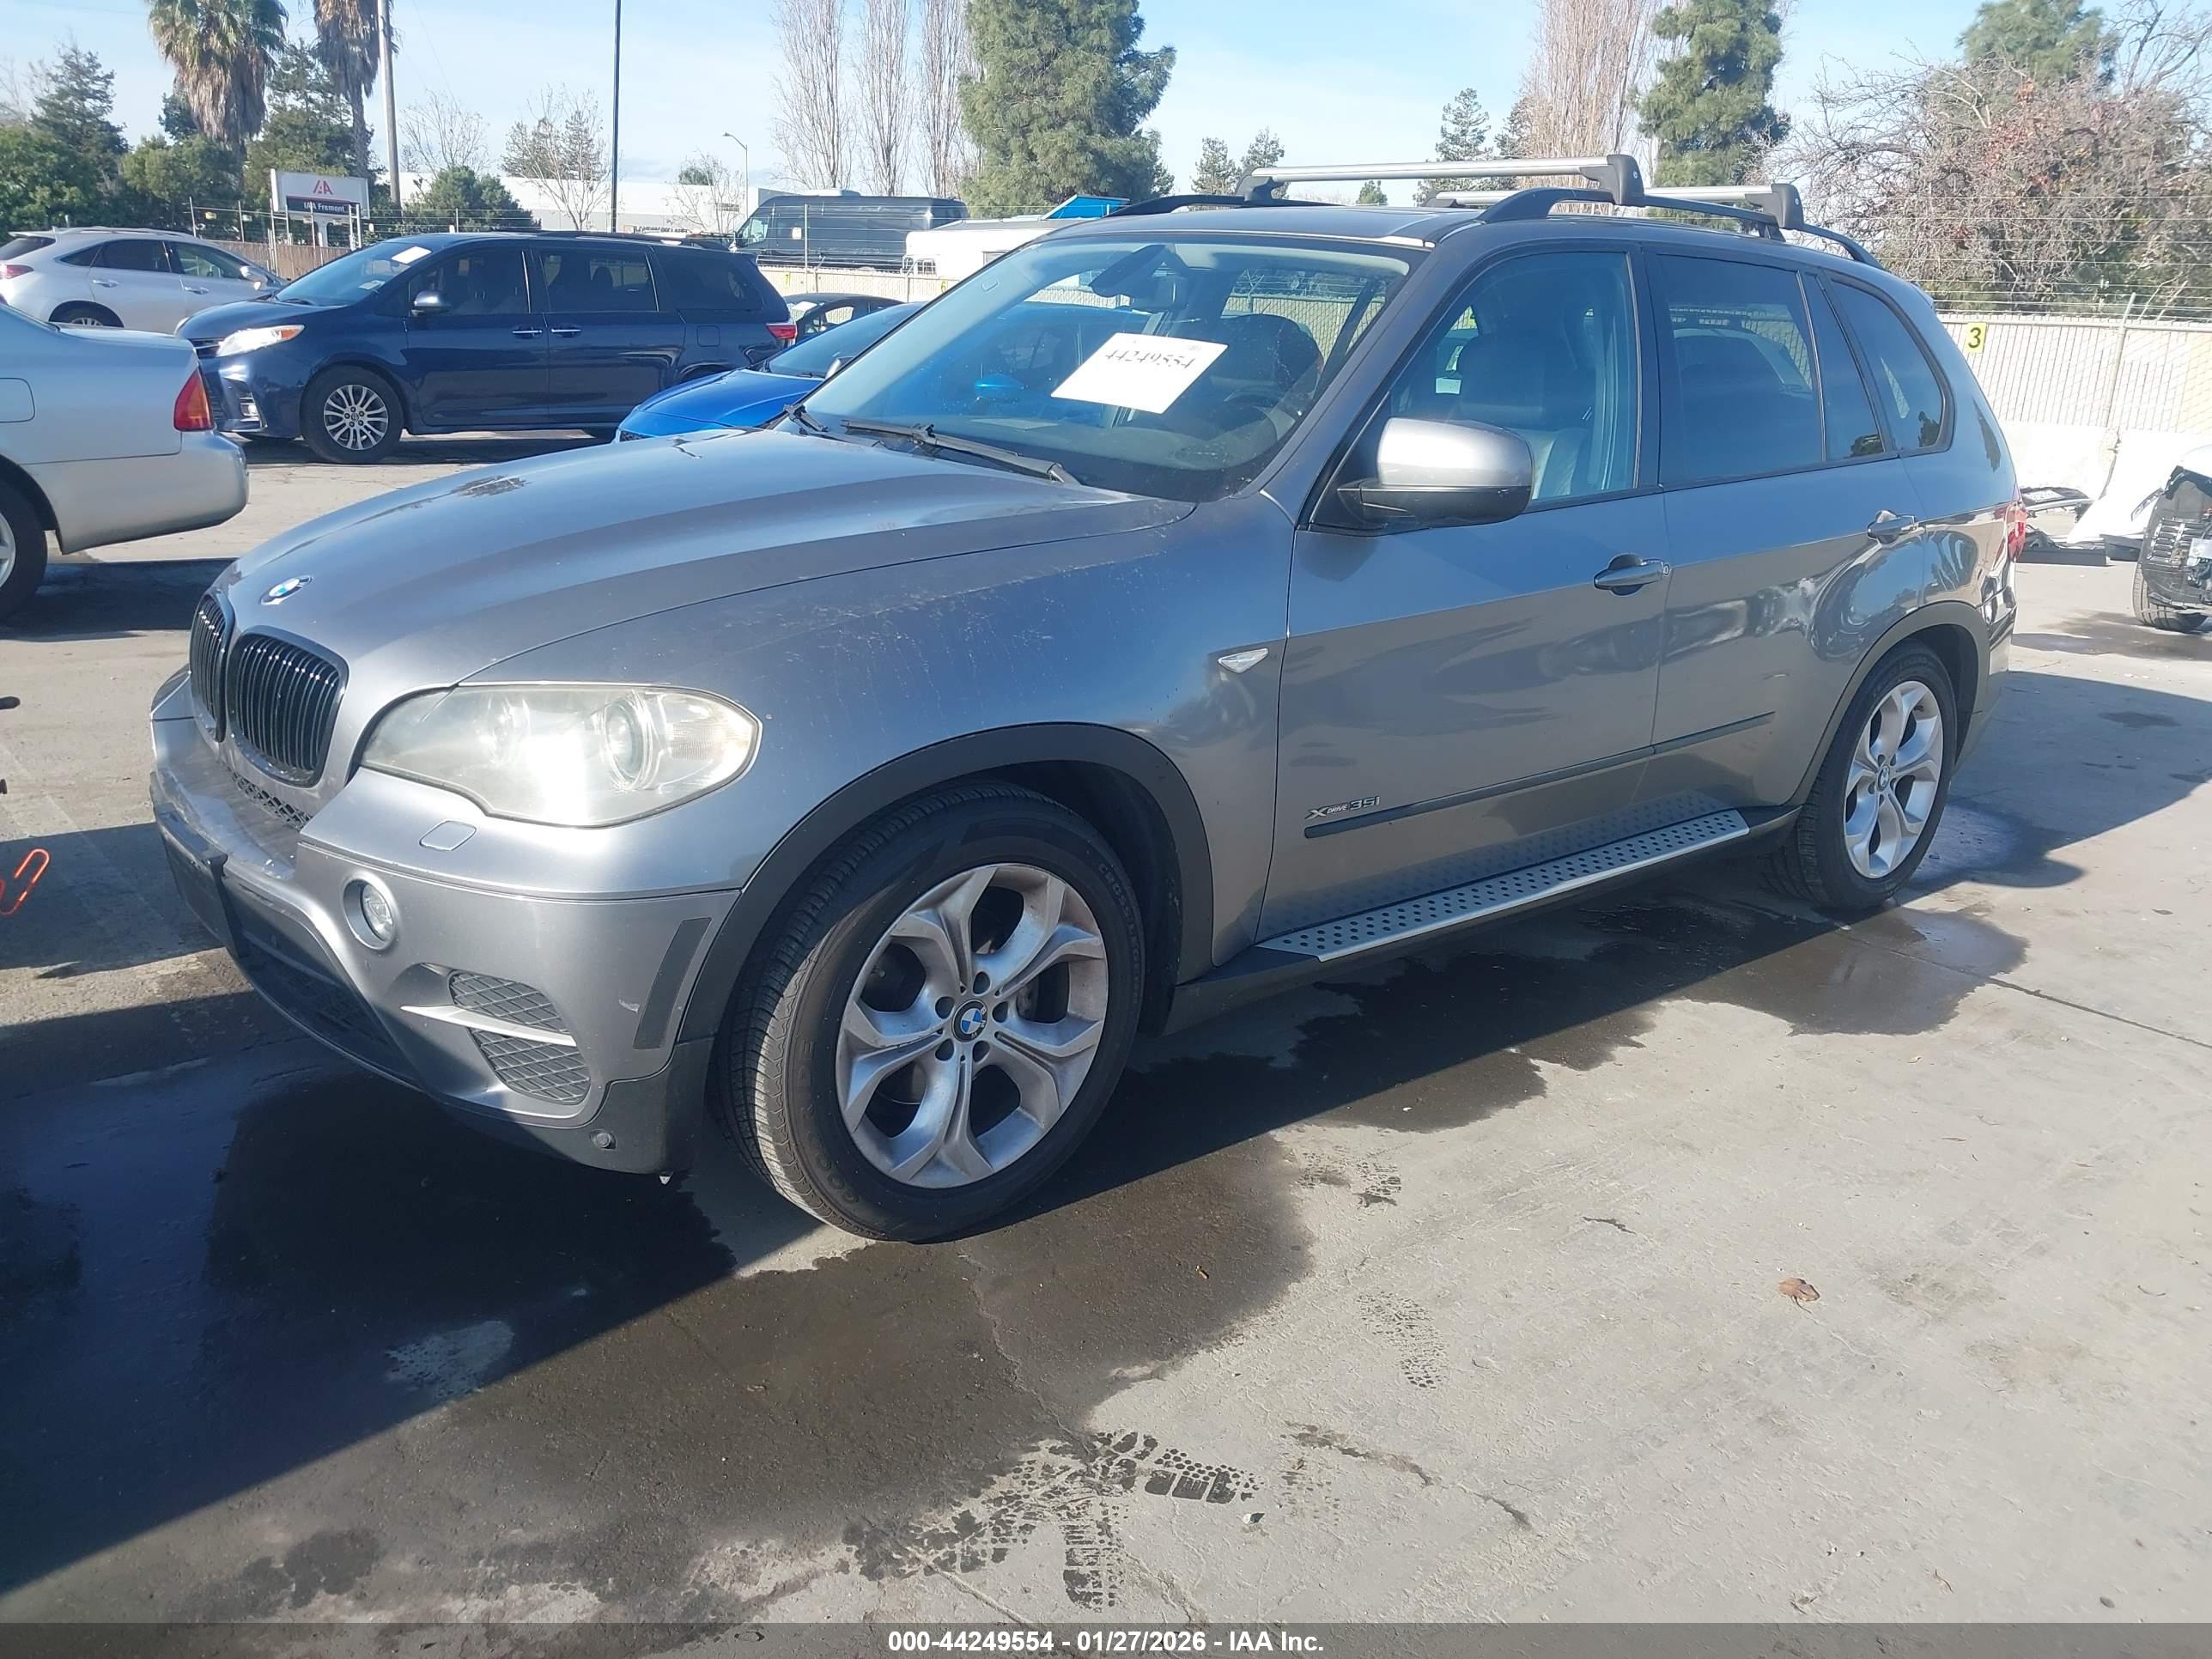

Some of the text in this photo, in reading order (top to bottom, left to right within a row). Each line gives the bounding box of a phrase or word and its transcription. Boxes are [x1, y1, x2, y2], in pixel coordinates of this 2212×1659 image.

[318, 203, 345, 213] Fremont
[941, 281, 946, 293] 6
[1968, 327, 1982, 349] 3
[1105, 349, 1196, 369] 44249554
